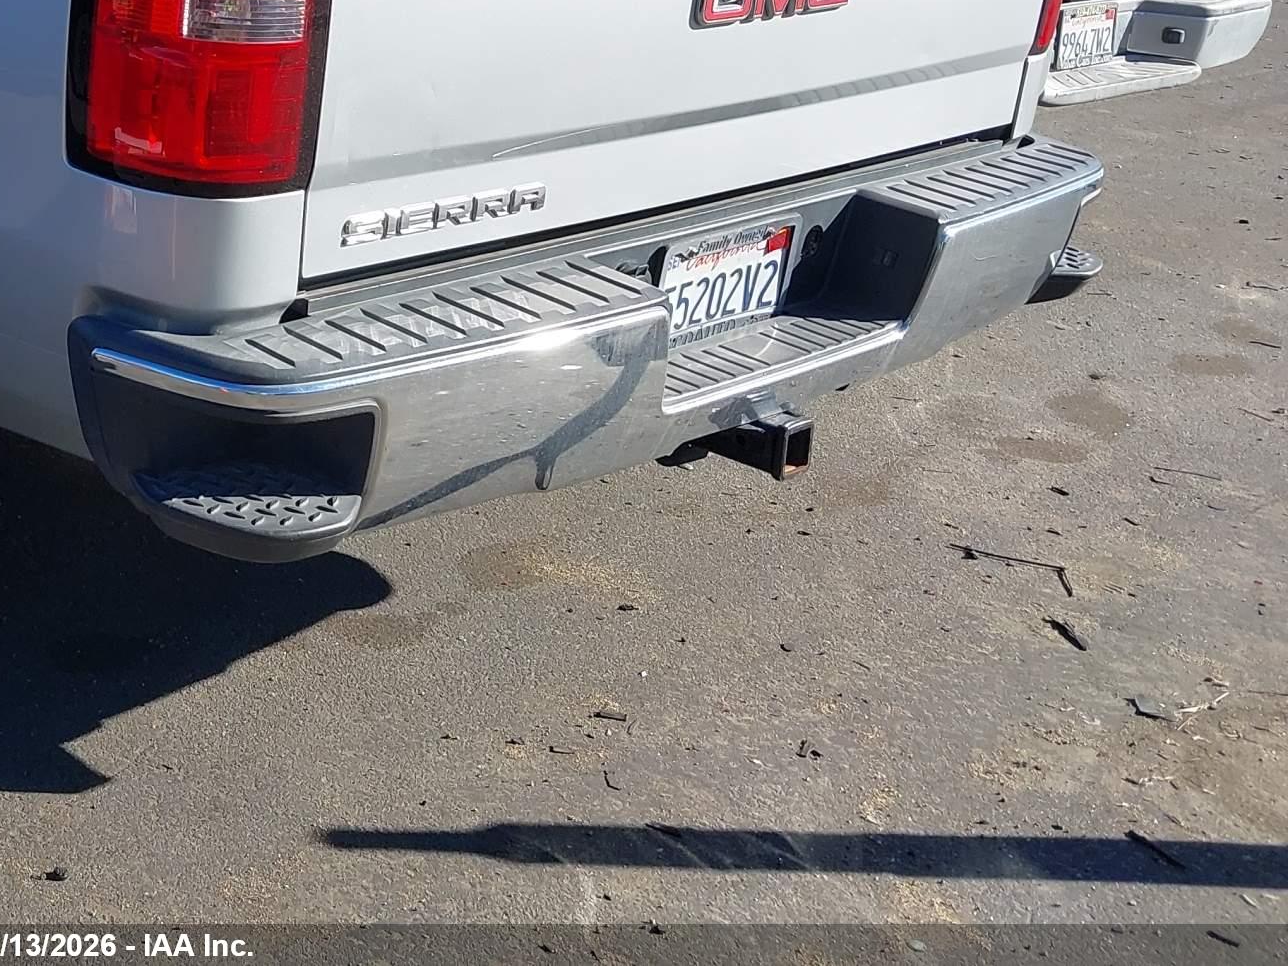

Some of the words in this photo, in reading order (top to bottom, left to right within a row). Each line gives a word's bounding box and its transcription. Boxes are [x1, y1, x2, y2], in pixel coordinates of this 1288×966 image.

[340, 183, 546, 247] SIERRA
[698, 235, 732, 254] Family
[733, 225, 769, 244] Owned
[665, 260, 779, 330] 5202V2
